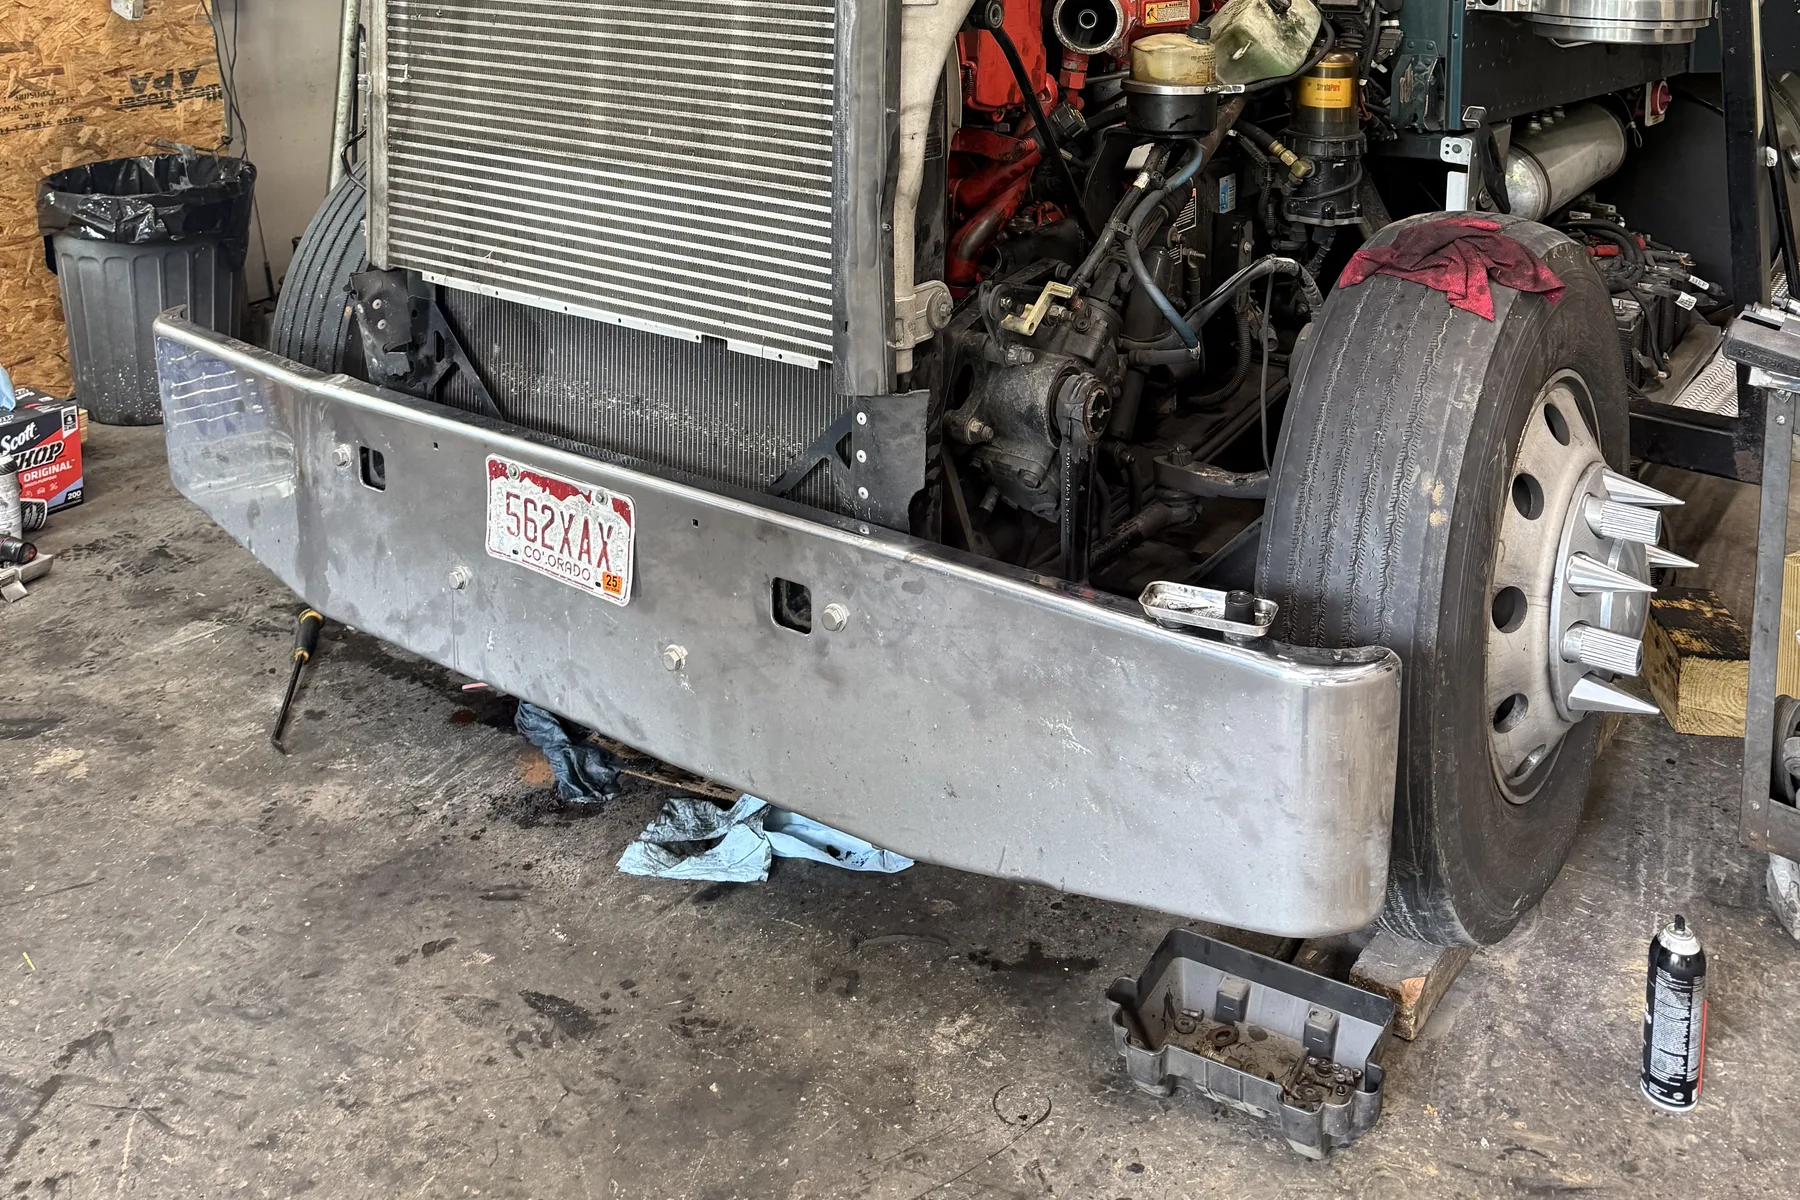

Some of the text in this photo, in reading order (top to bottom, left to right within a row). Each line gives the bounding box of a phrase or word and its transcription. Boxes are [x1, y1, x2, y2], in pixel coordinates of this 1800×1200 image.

[129, 68, 199, 94] APA
[0, 421, 36, 456] Scott
[13, 442, 64, 470] HOP
[23, 460, 73, 482] ORIGINAL
[67, 490, 82, 500] 200
[505, 491, 614, 572] 562XAX
[606, 574, 618, 588] 25
